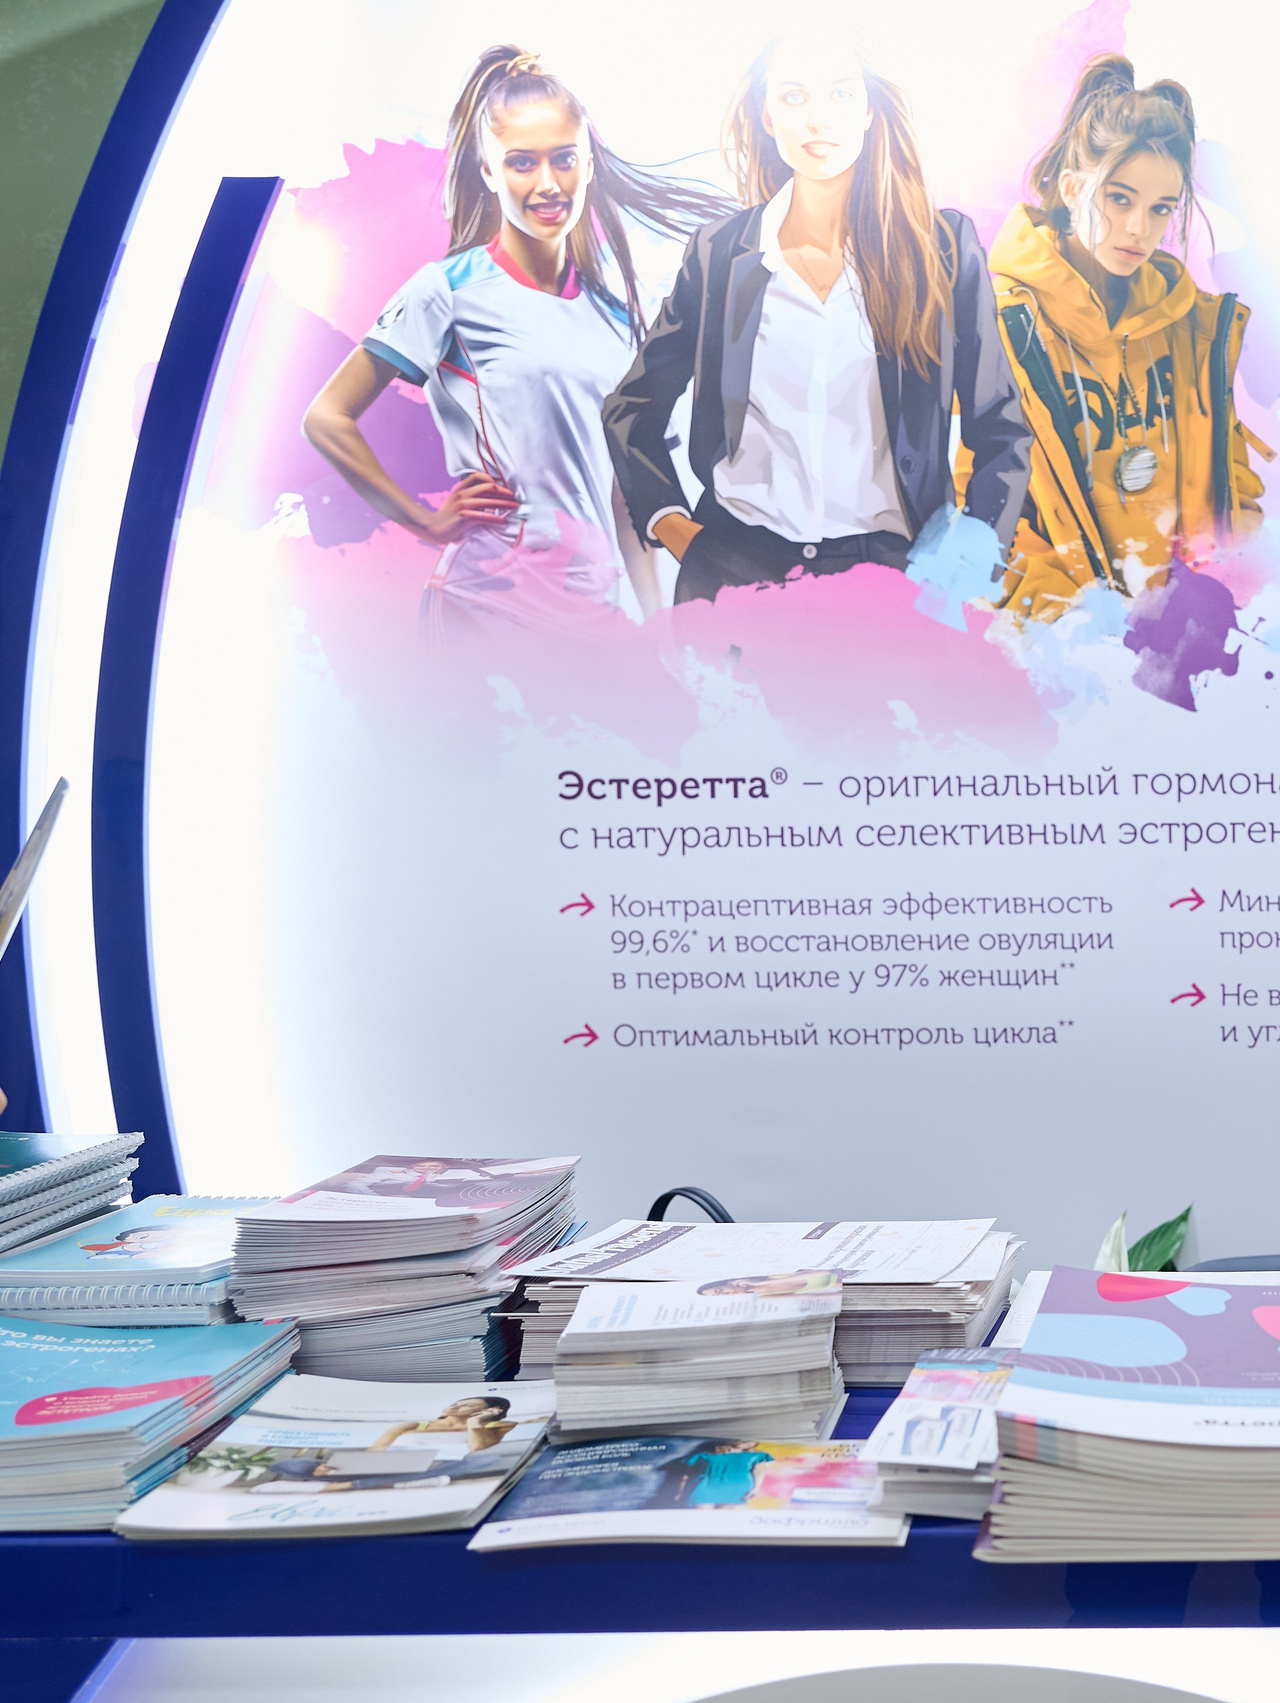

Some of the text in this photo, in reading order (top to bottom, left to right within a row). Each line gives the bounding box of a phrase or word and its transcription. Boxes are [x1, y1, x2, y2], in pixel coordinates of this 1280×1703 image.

[558, 767, 788, 806] Эстеретта®
[839, 766, 1119, 805] оригинальный
[559, 828, 579, 849] с
[592, 823, 843, 856] натуральным
[856, 819, 1105, 848] селективным
[610, 891, 1113, 924] Контрацептивная эффективность
[708, 934, 726, 953] и
[736, 930, 970, 953] восстановление
[979, 928, 1114, 958] овуляции
[612, 970, 626, 989] в
[637, 969, 746, 995] первом
[756, 967, 840, 993] цикле
[848, 967, 866, 993] у
[874, 964, 930, 988] 97%
[1220, 983, 1258, 1007] Не
[613, 1020, 818, 1050] Оптимальный
[829, 1025, 964, 1051] контроль
[1220, 1024, 1238, 1042] и
[2, 1340, 156, 1353] эстрогенах?
[32, 1334, 66, 1343] вы
